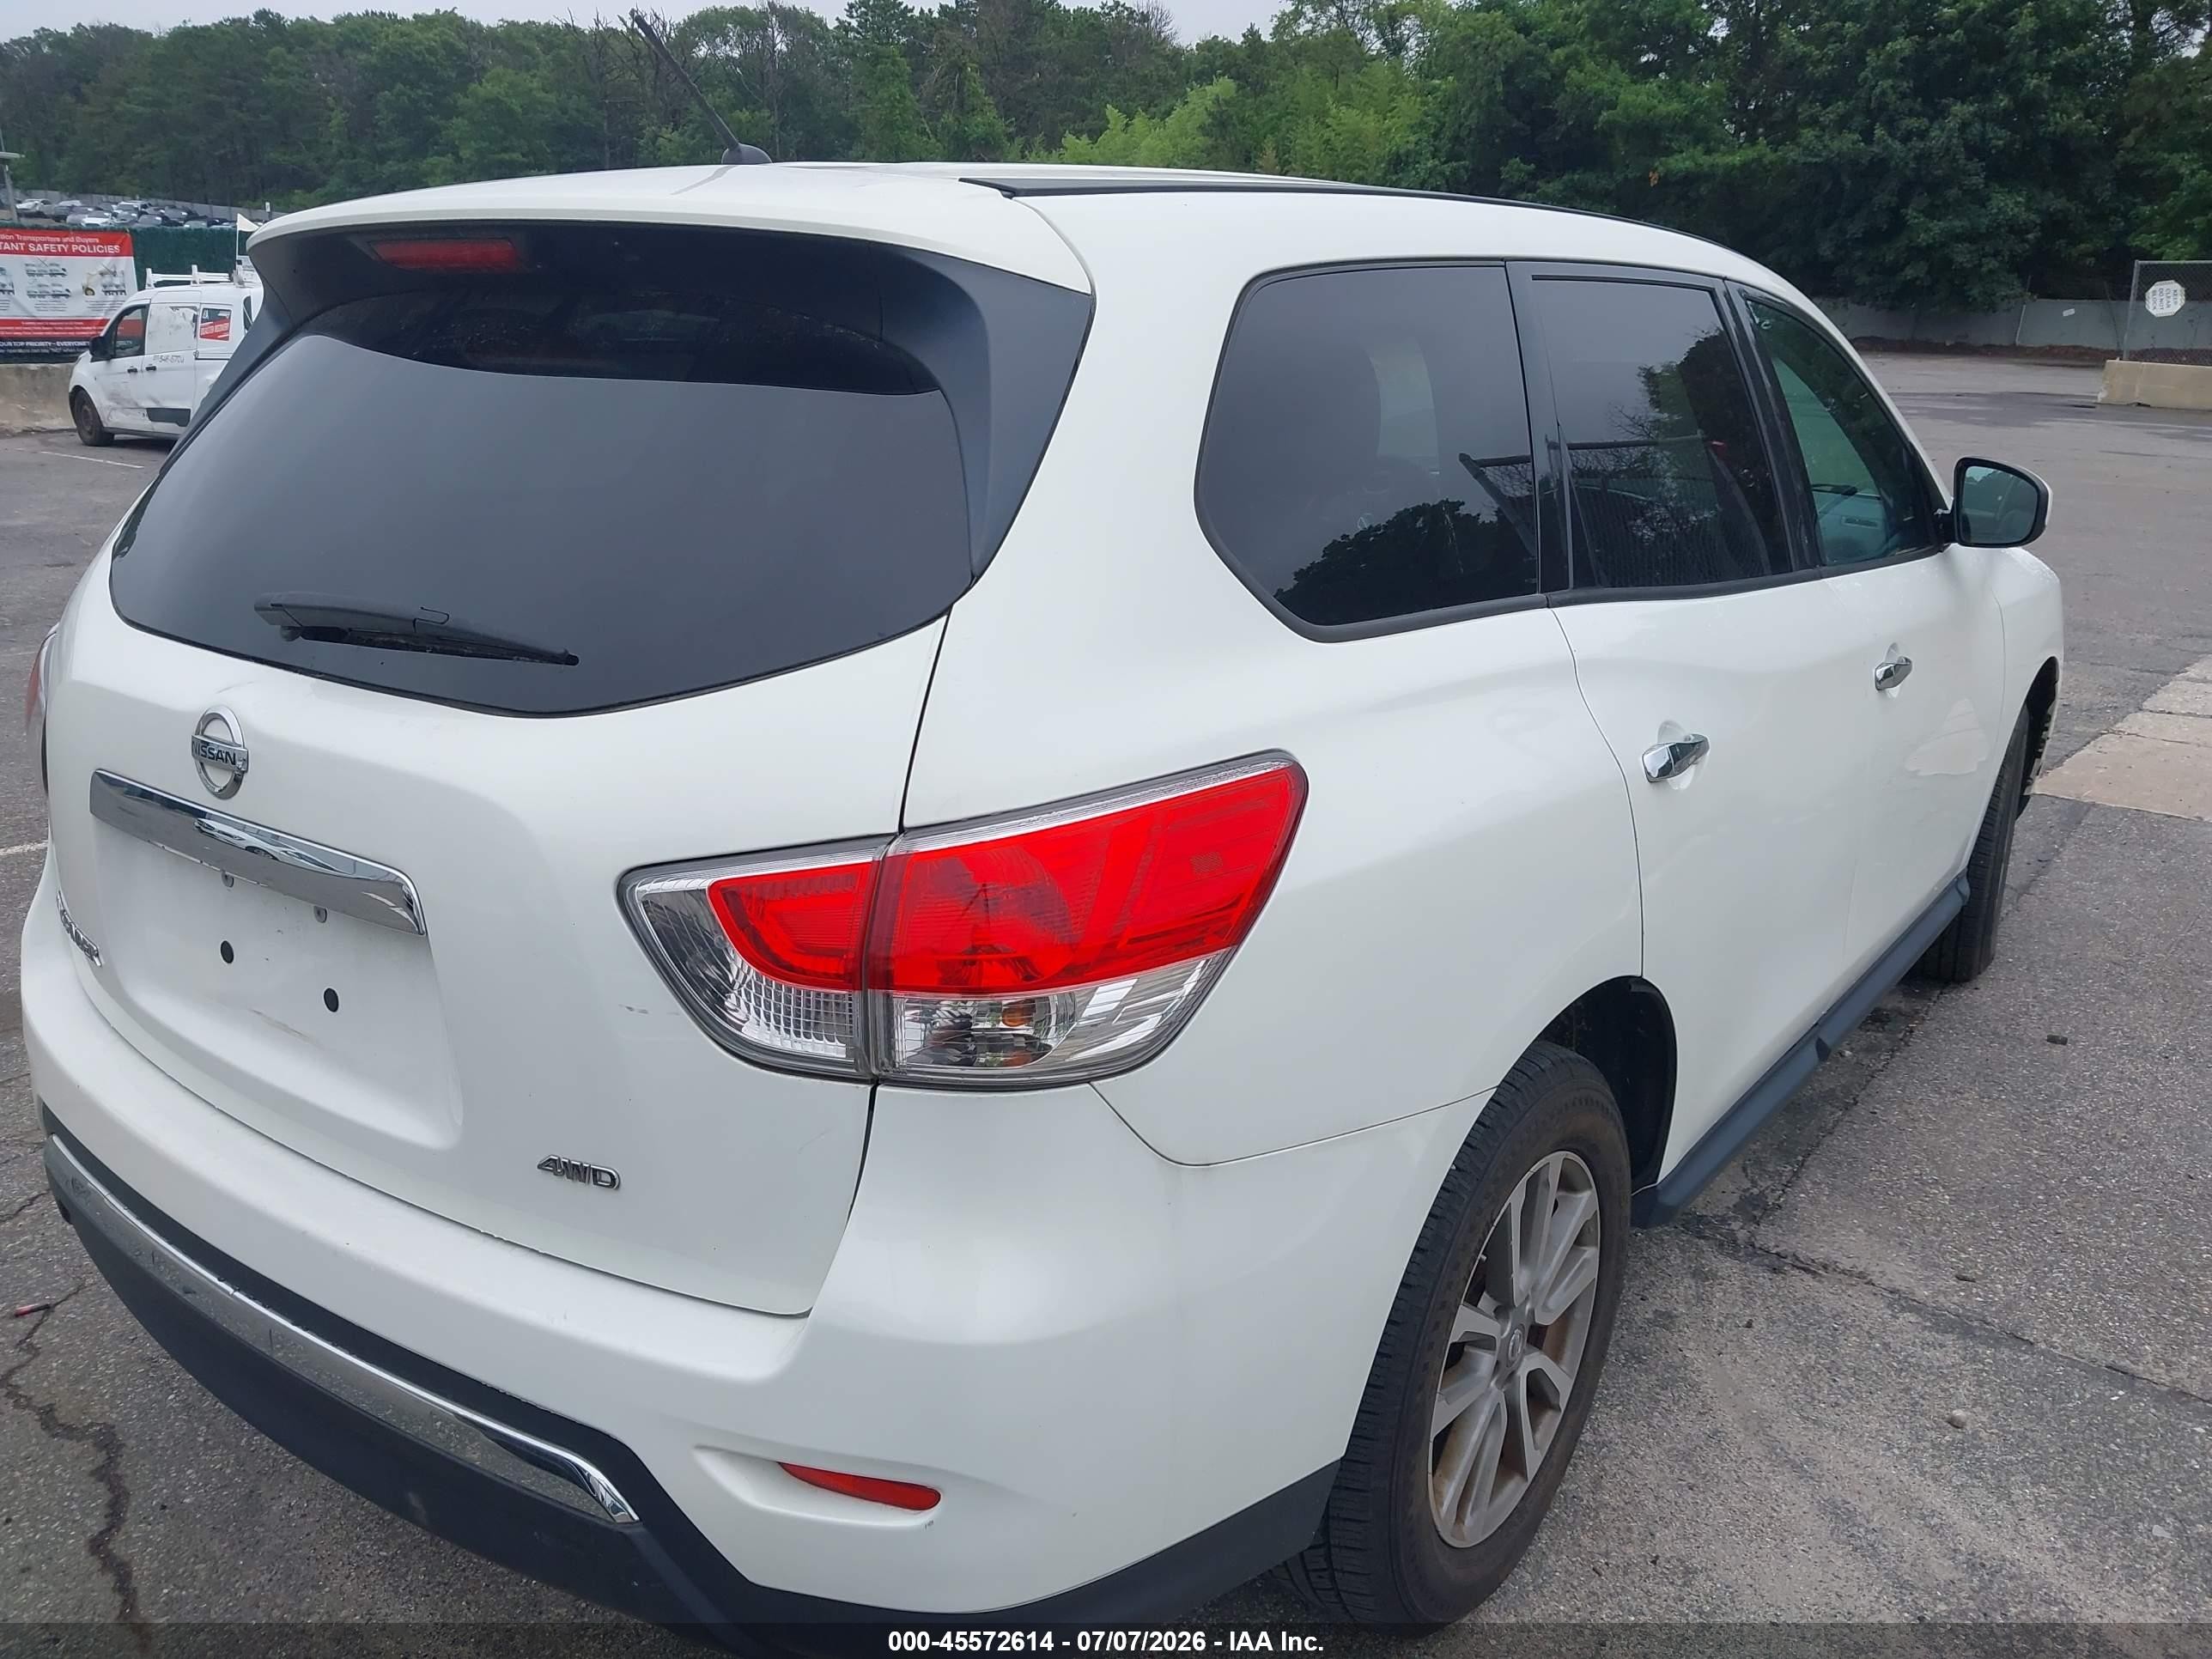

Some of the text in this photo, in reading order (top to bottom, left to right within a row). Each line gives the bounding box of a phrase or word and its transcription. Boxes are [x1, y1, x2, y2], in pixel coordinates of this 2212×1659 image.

[28, 242, 69, 252] SAFETY
[71, 244, 120, 253] POLICIES
[191, 740, 236, 766] NISSAN
[537, 1154, 621, 1190] 4WD
